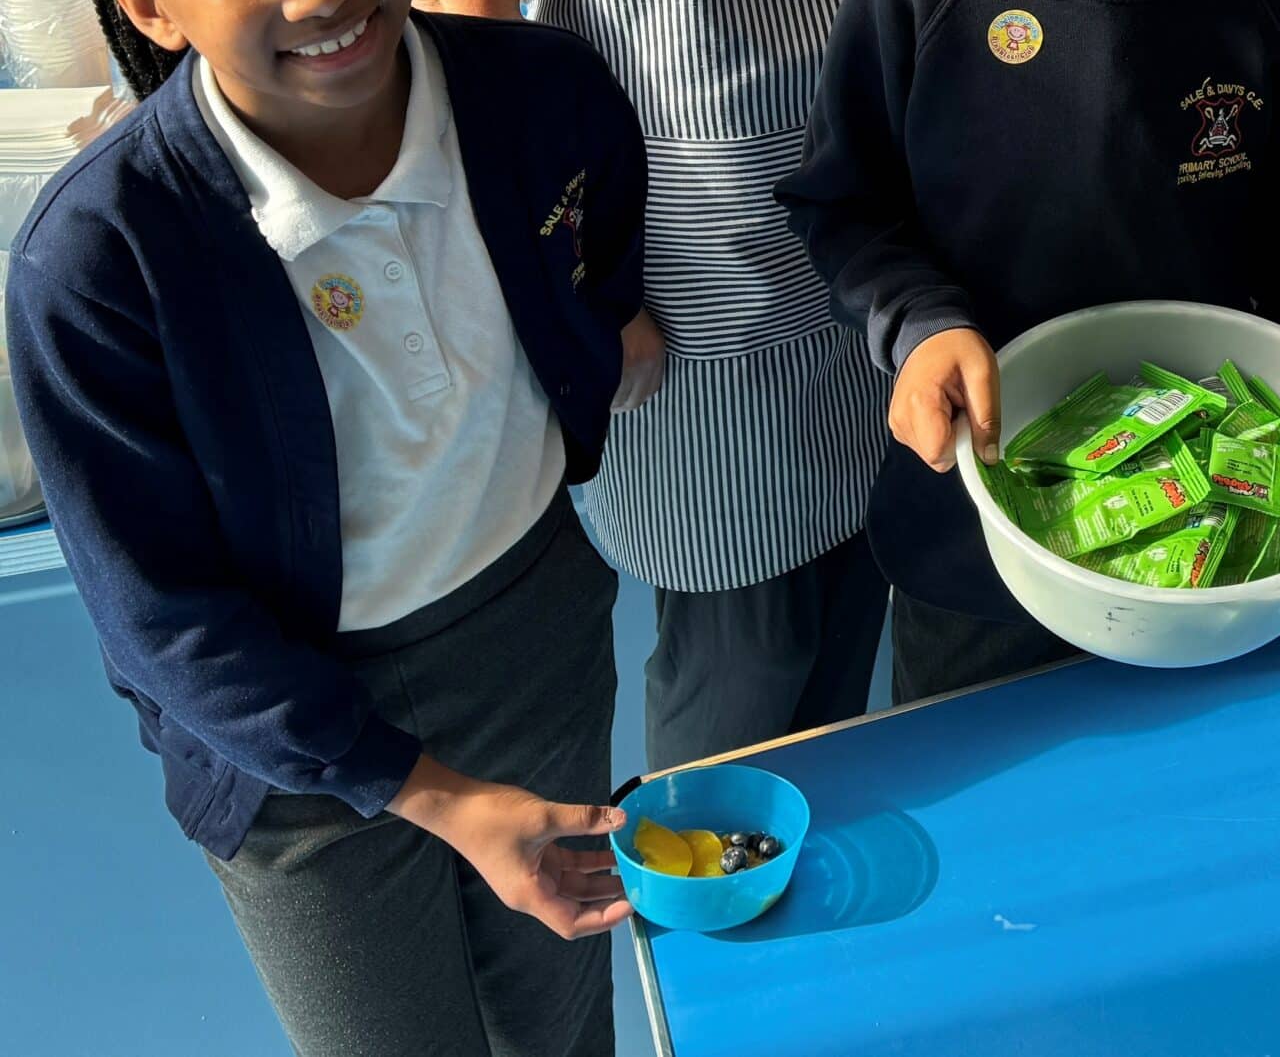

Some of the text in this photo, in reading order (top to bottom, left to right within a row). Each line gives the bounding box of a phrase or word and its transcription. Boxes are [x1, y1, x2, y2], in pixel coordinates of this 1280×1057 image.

[1180, 89, 1205, 110] SALE
[1206, 86, 1215, 96] &
[1178, 159, 1216, 175] PRIMARY
[539, 204, 565, 236] SALE
